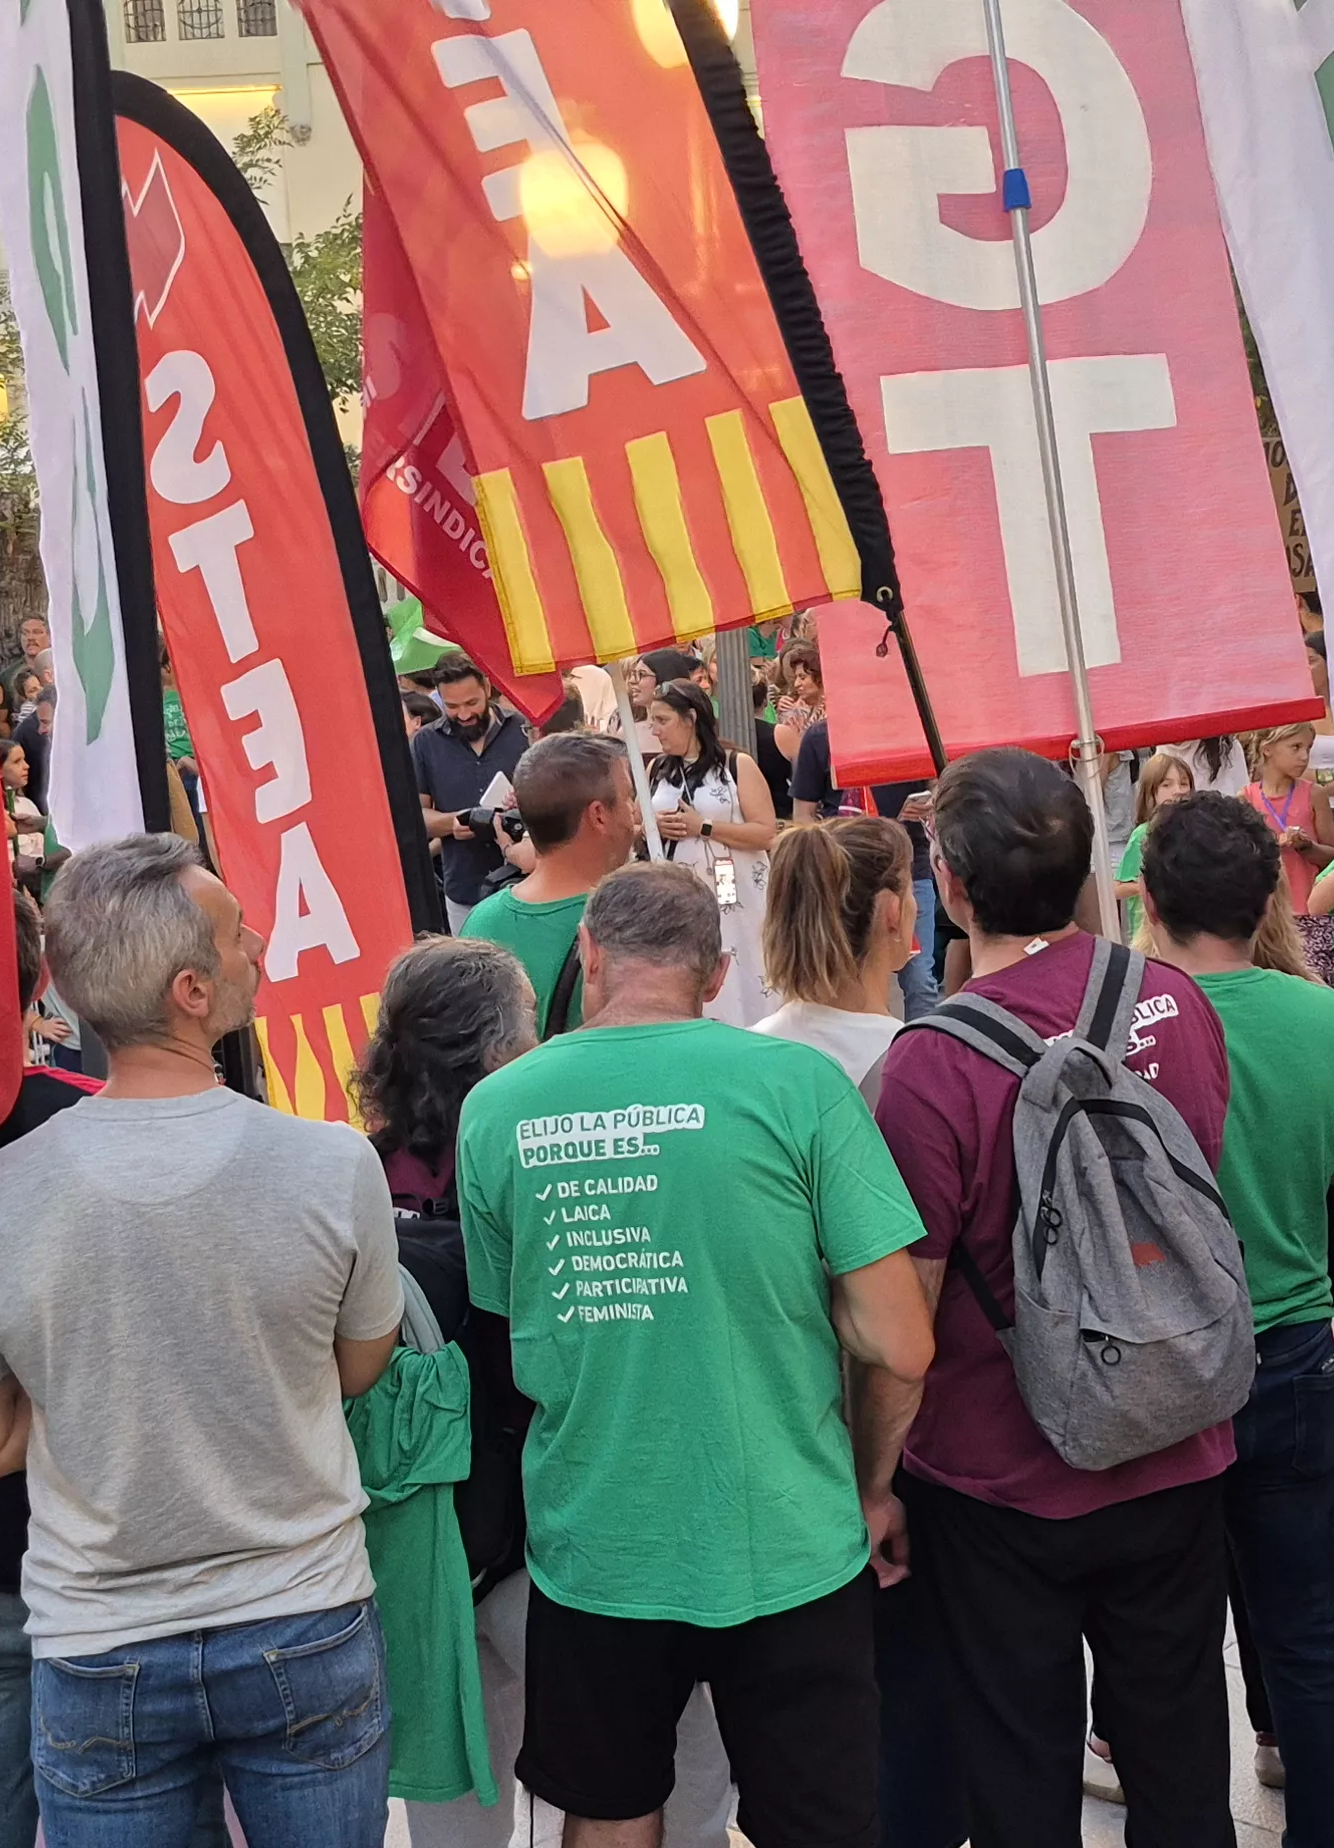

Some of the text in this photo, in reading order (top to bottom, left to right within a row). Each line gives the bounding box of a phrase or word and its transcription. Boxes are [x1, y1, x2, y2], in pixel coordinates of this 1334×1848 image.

[520, 1105, 701, 1141] ELIJO LA PÚBLICA
[523, 1136, 659, 1166] PORQUE ES...
[557, 1174, 659, 1198] DE CALIDAD
[561, 1204, 612, 1223] LAICA
[566, 1227, 651, 1248] INCLUSIVA
[571, 1248, 685, 1272] DEMOCRÁTICA
[575, 1276, 689, 1298] PARTICIPATIVA
[578, 1302, 655, 1323] FEMINISTA
